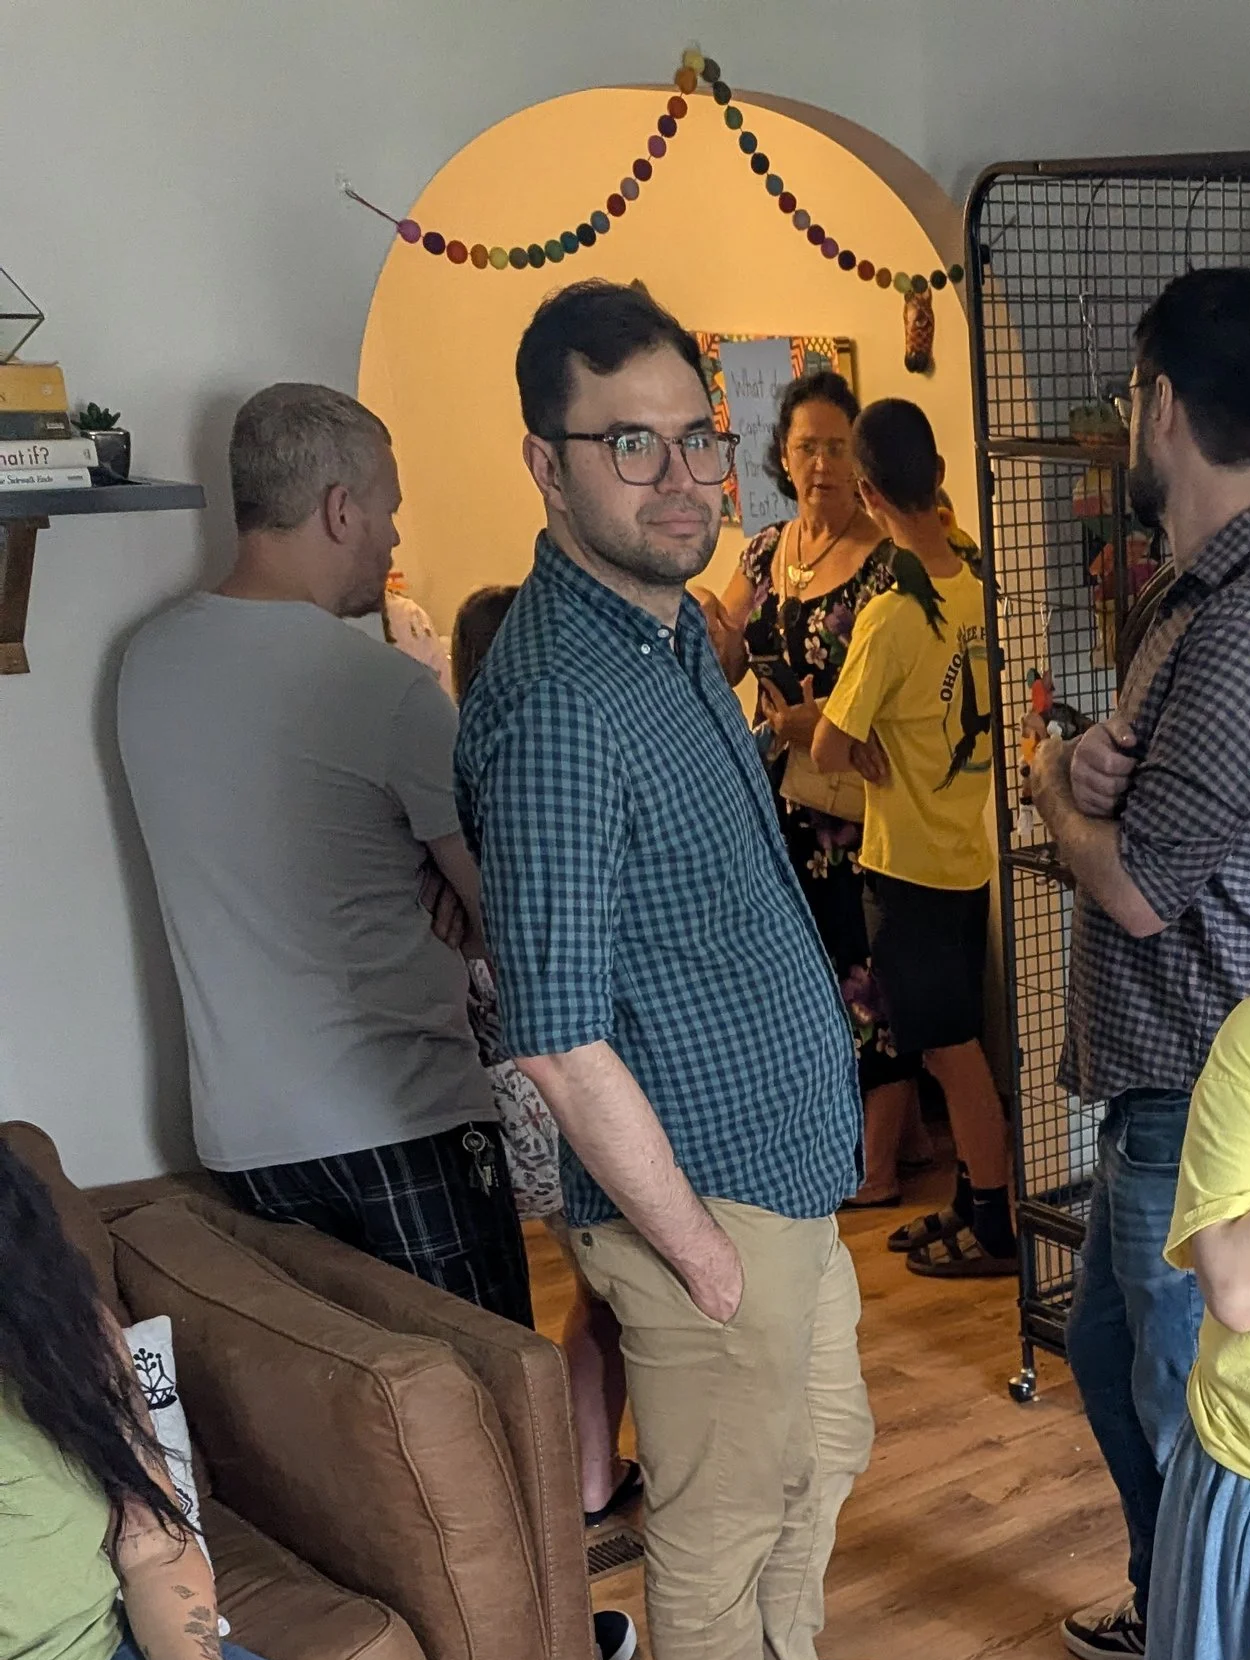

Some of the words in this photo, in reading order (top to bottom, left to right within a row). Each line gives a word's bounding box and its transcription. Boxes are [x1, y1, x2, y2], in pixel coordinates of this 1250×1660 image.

[730, 367, 764, 398] What
[28, 446, 49, 464] if?
[940, 653, 962, 702] OHIO
